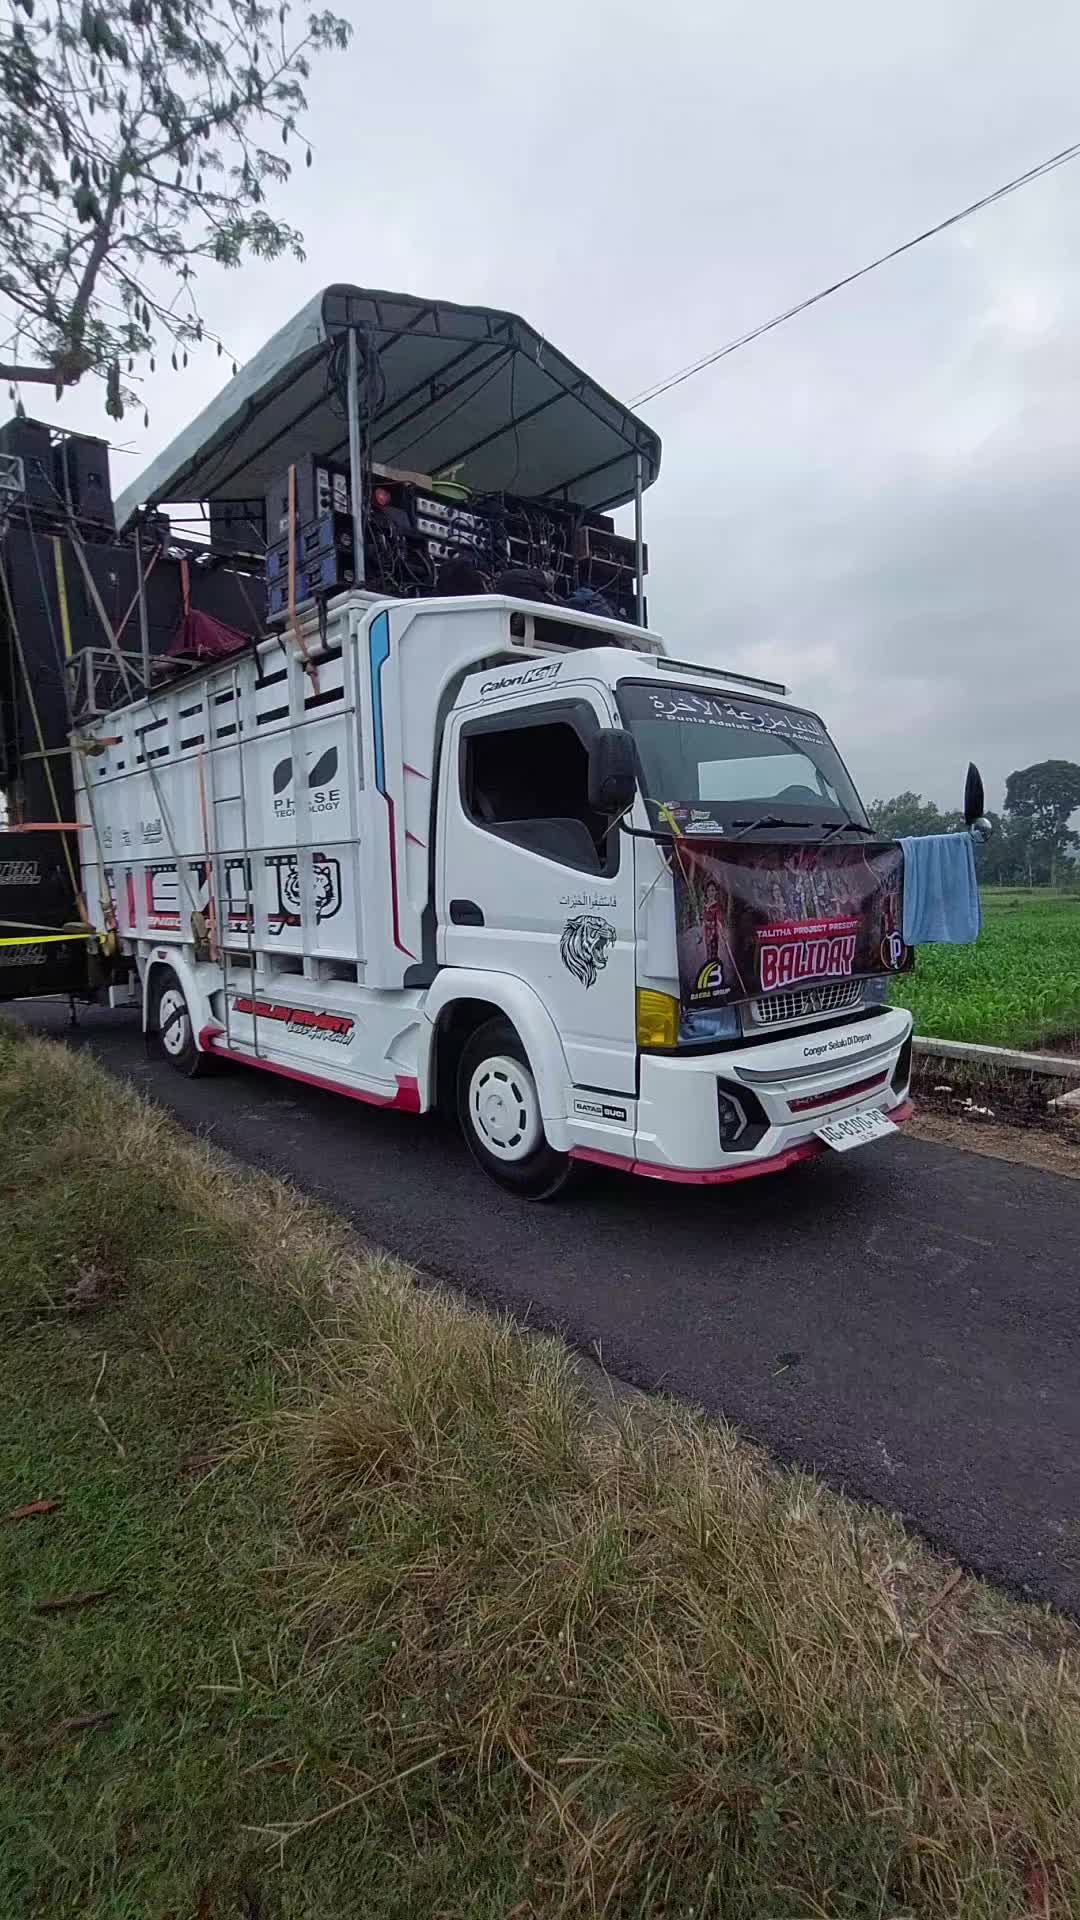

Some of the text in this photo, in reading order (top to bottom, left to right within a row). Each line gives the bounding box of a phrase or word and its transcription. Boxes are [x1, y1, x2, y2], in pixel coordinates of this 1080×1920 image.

[480, 676, 522, 695] Calon
[756, 928, 791, 938] TALITHA
[794, 923, 827, 935] PROJECT
[760, 935, 857, 992] BALIDAY
[847, 1036, 854, 1046] Di
[576, 1103, 625, 1119] BATAS SUCI
